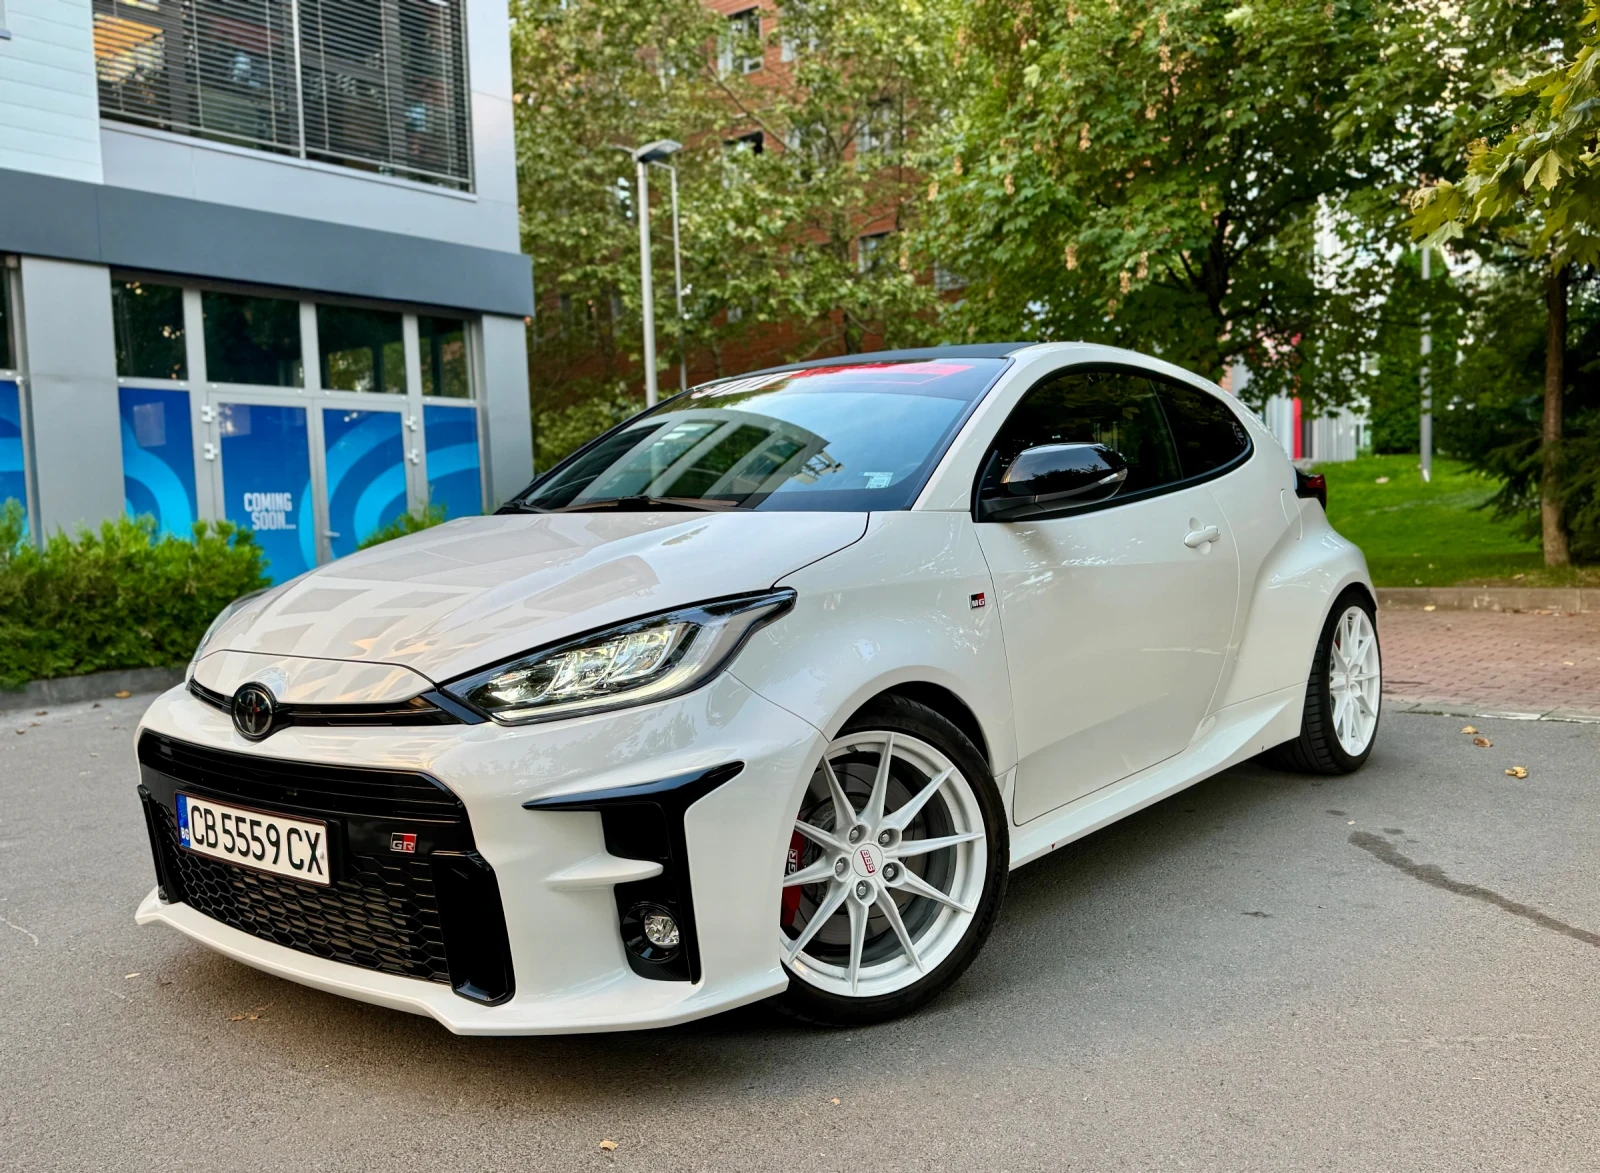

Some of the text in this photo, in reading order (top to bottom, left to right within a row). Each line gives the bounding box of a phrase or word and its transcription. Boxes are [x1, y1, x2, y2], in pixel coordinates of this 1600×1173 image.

[243, 492, 293, 512] COMING
[180, 826, 190, 841] BG
[392, 840, 415, 851] GR
[788, 849, 797, 874] GR
[860, 850, 875, 873] BBS
